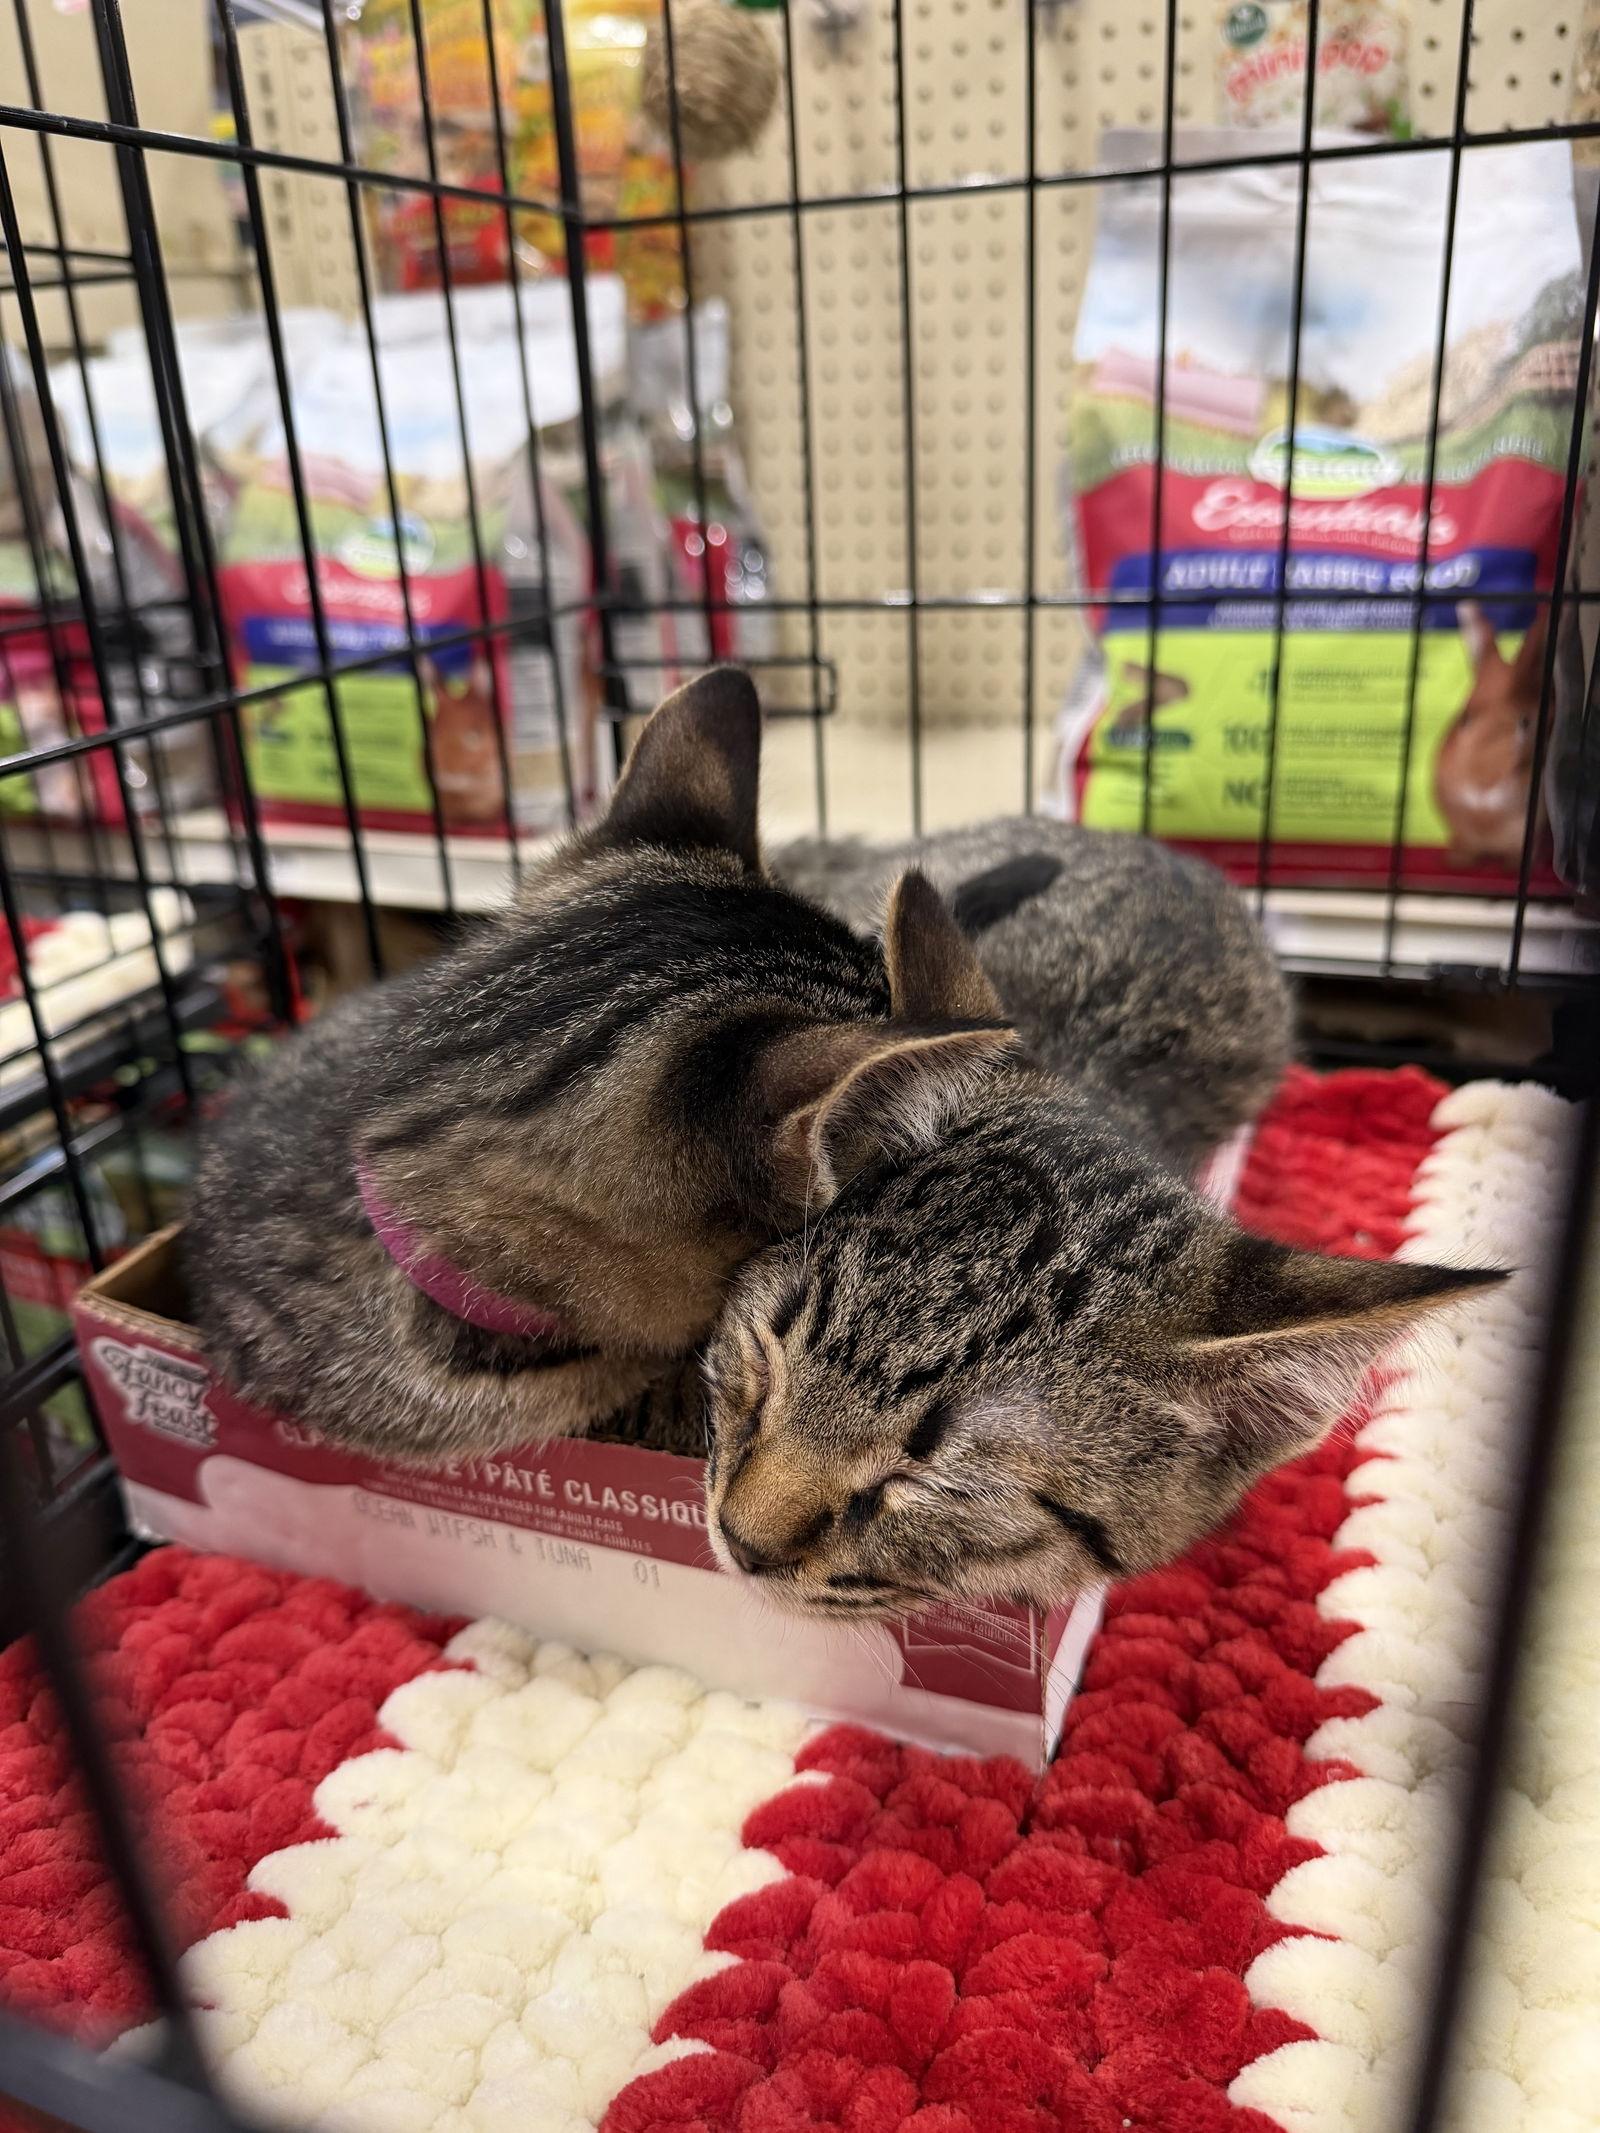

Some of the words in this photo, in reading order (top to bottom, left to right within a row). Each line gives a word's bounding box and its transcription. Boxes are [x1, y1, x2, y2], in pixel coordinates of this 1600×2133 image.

[1164, 554, 1271, 591] ADULT
[102, 1346, 206, 1410] Fancy
[128, 1382, 215, 1440] Feast
[483, 1461, 555, 1499] PÂTÉ
[562, 1480, 709, 1528] CLASSIQU
[535, 1536, 593, 1573] TUNA
[632, 1559, 661, 1588] 01
